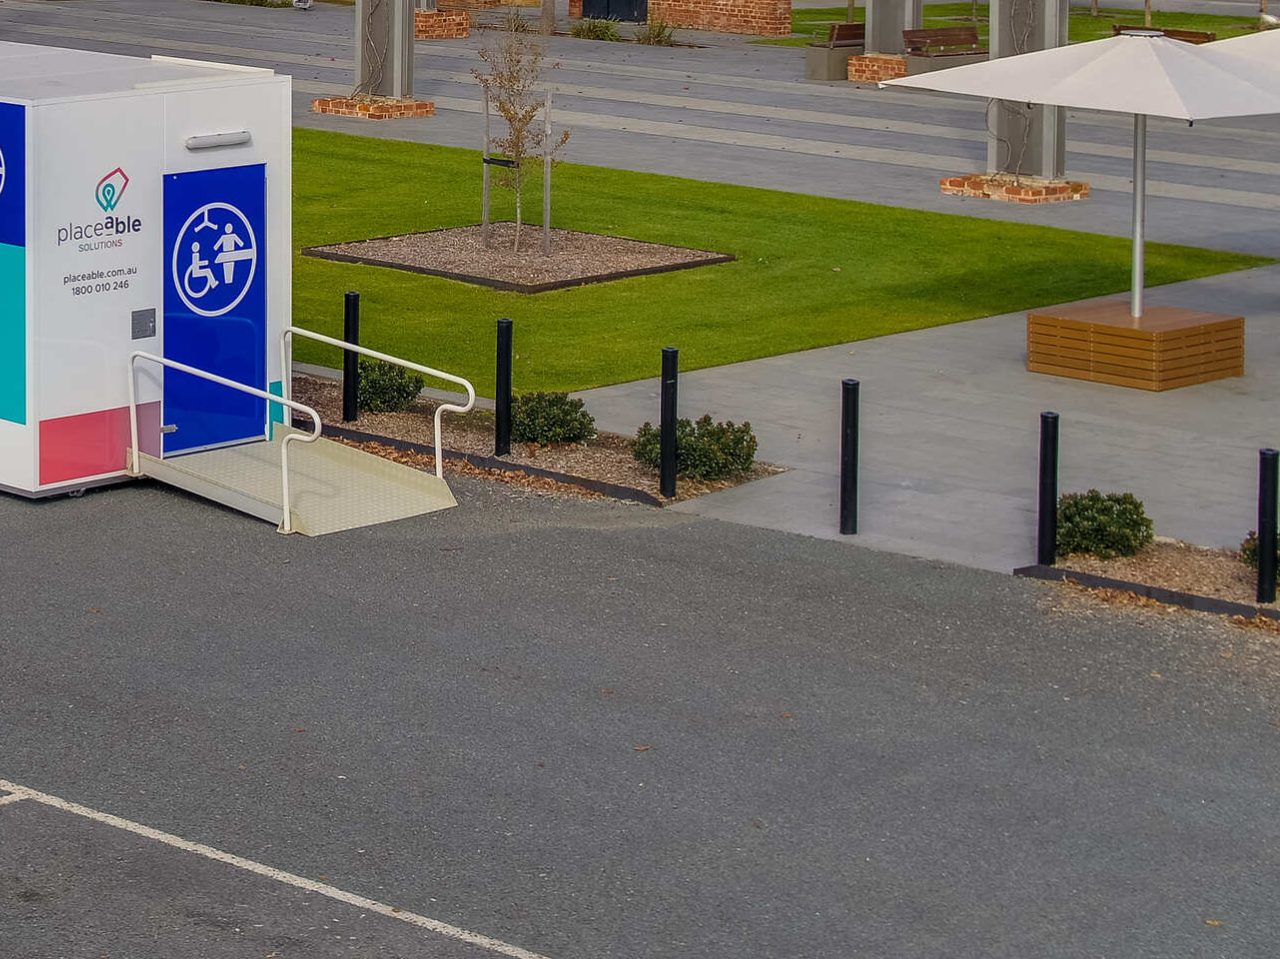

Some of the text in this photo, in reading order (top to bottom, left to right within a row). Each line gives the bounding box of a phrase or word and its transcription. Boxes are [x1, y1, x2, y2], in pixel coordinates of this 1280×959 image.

[56, 215, 142, 247] placeable
[78, 239, 124, 252] SOLUTIONS
[63, 266, 138, 286] placeable.com.au
[72, 279, 130, 296] 1800 010 246
